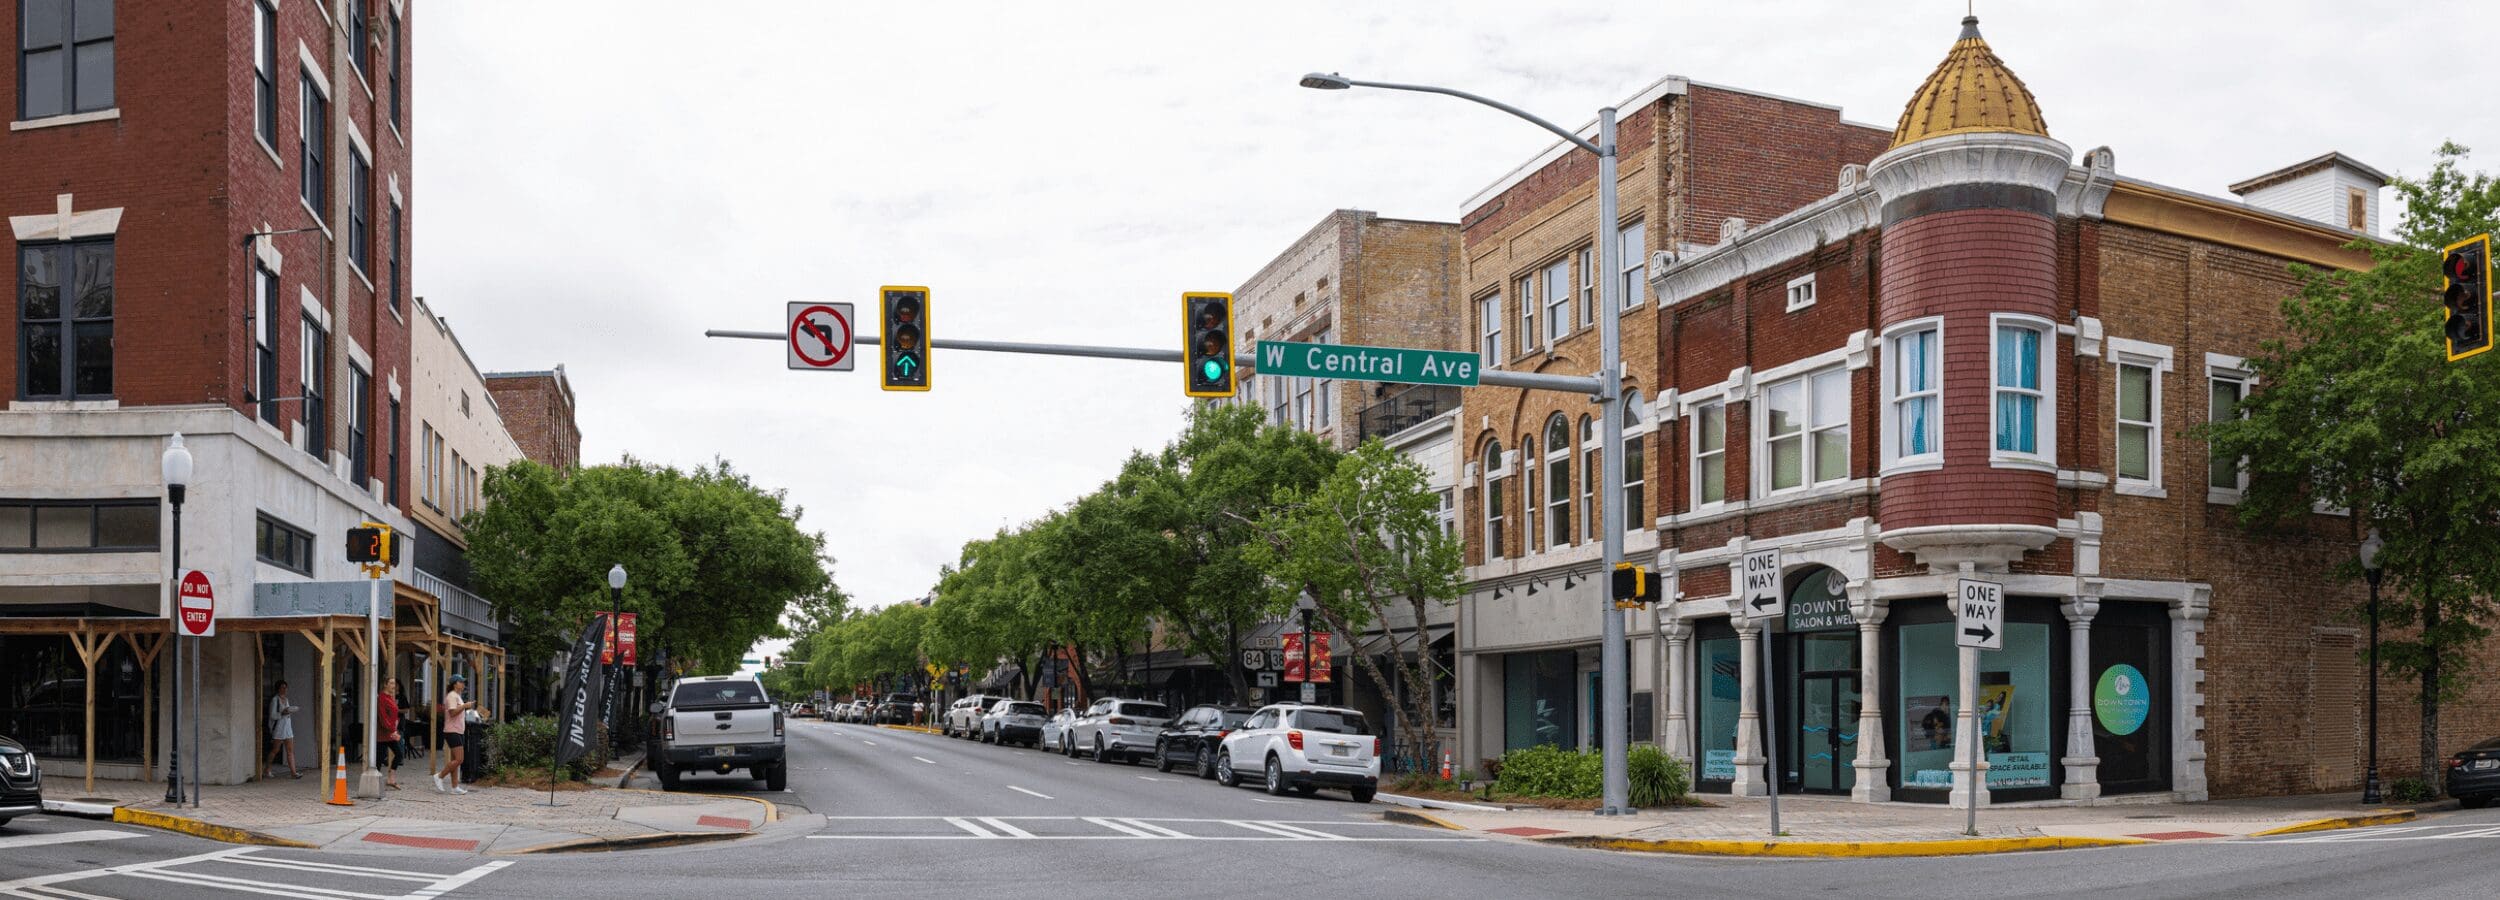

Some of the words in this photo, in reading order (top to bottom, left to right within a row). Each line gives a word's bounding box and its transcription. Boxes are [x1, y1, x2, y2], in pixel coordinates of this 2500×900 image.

[1266, 345, 1284, 368] W
[1307, 348, 1402, 375] Central
[1421, 354, 1472, 379] Ave
[370, 535, 379, 555] 2
[1749, 554, 1775, 571] ONE
[184, 582, 193, 592] DO
[197, 584, 209, 594] NOT
[1748, 572, 1775, 590] WAY
[1967, 585, 1996, 602] ONE
[187, 611, 207, 622] ENTER
[1965, 603, 1997, 620] WAY
[1795, 616, 1824, 629] SALON
[1825, 615, 1833, 626] &
[1259, 639, 1274, 647] EAST
[580, 641, 596, 684] NOW
[1245, 652, 1262, 666] 84
[570, 689, 587, 748] OPEN!
